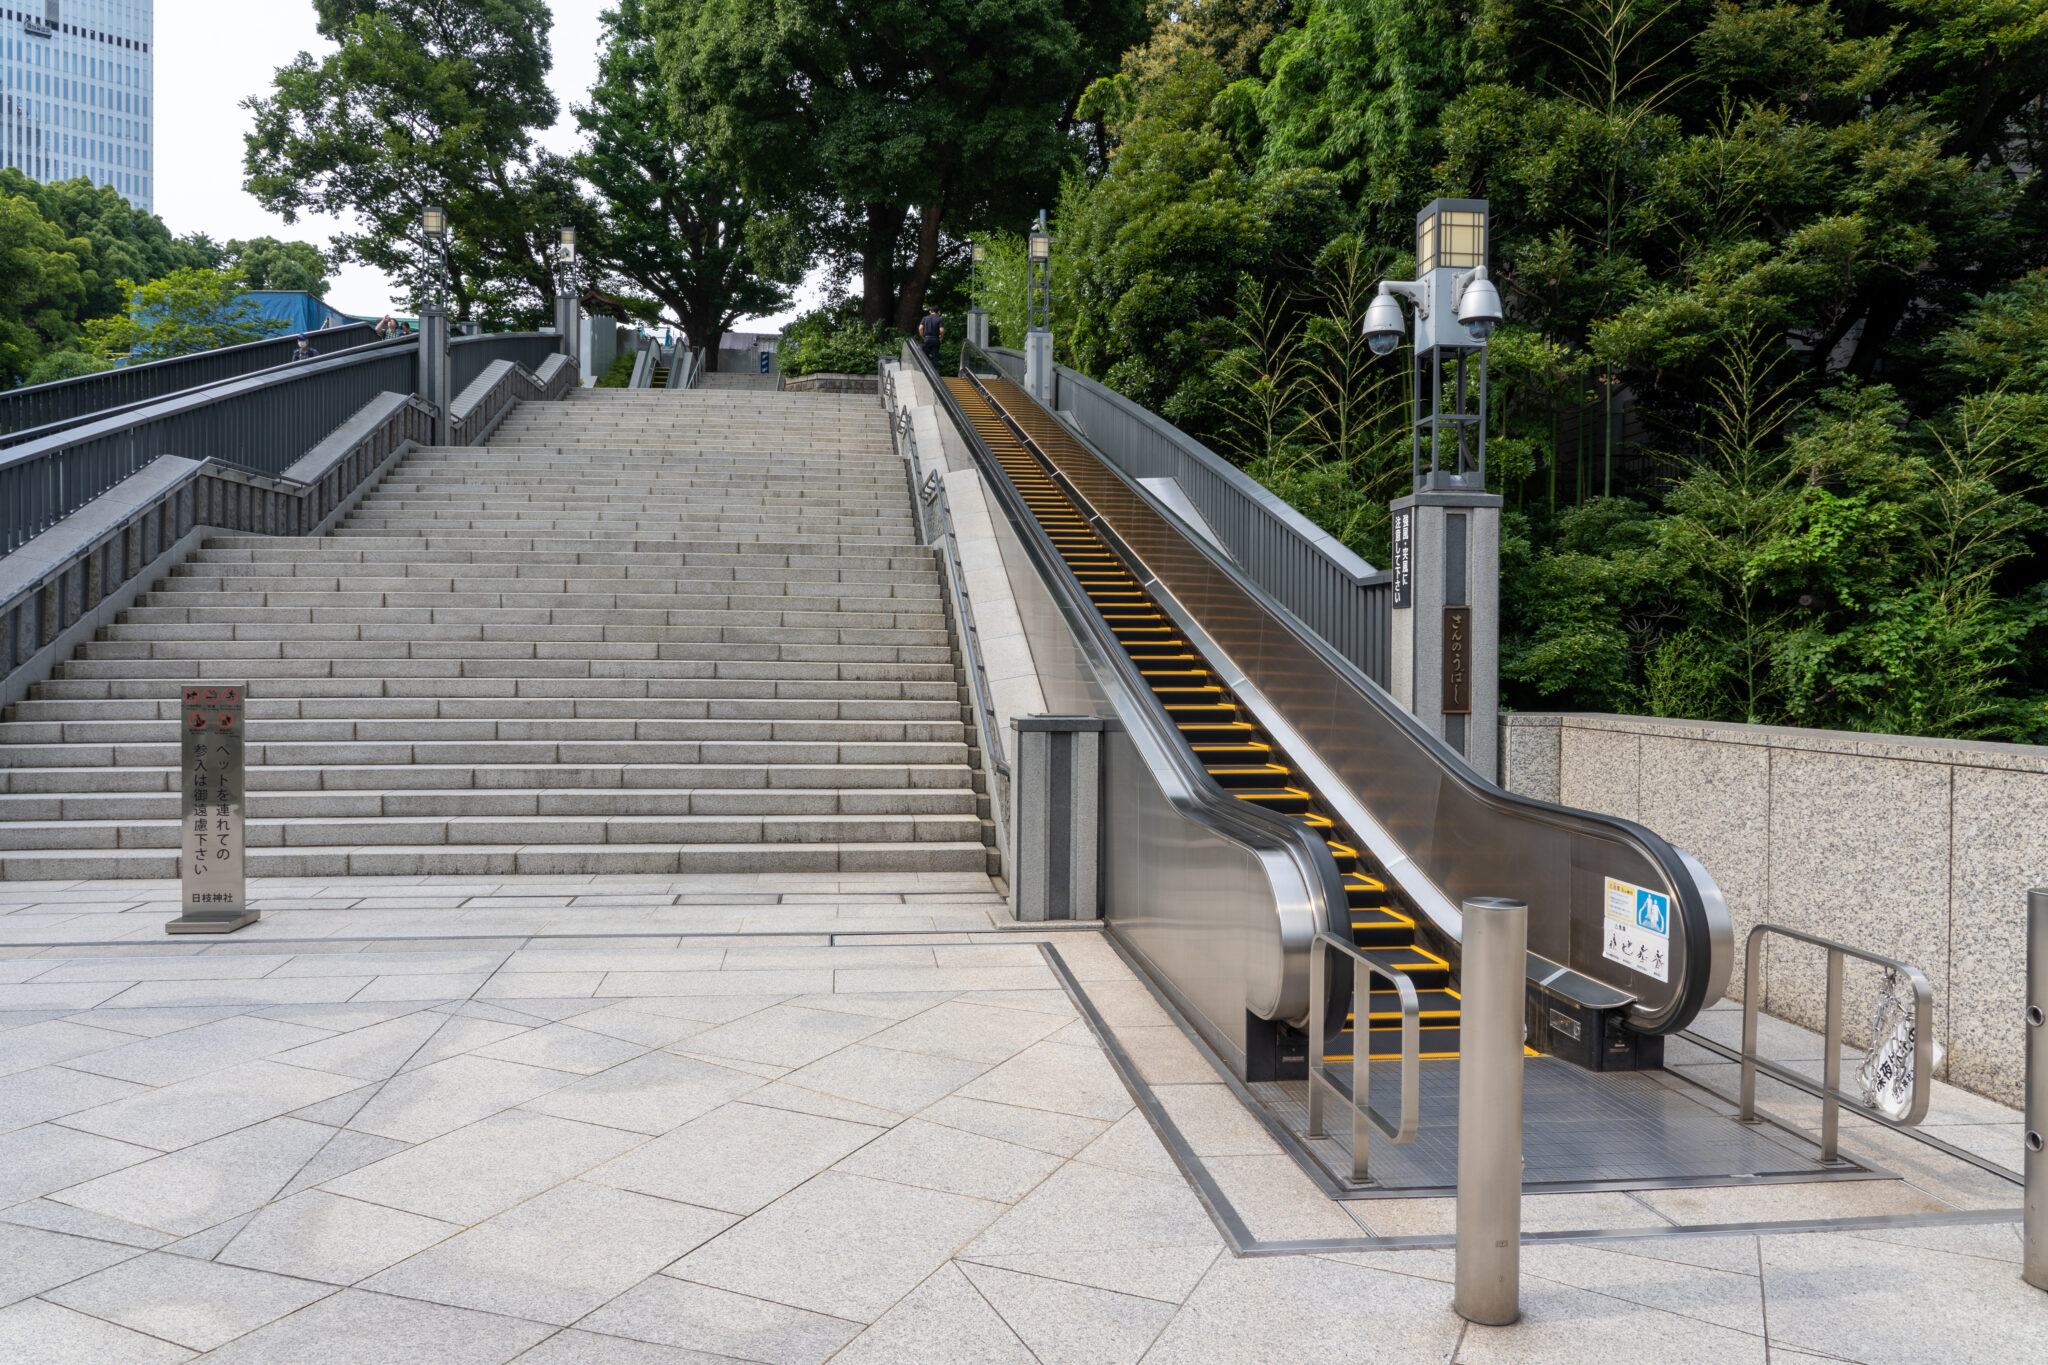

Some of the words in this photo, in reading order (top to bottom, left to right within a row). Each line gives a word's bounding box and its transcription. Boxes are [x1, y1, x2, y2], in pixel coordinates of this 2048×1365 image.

[1450, 614, 1465, 705] さんのうばし
[194, 744, 207, 875] 参入は御遠慮下さい
[216, 745, 230, 860] ペットを連れての
[192, 893, 233, 903] 日枝神社
